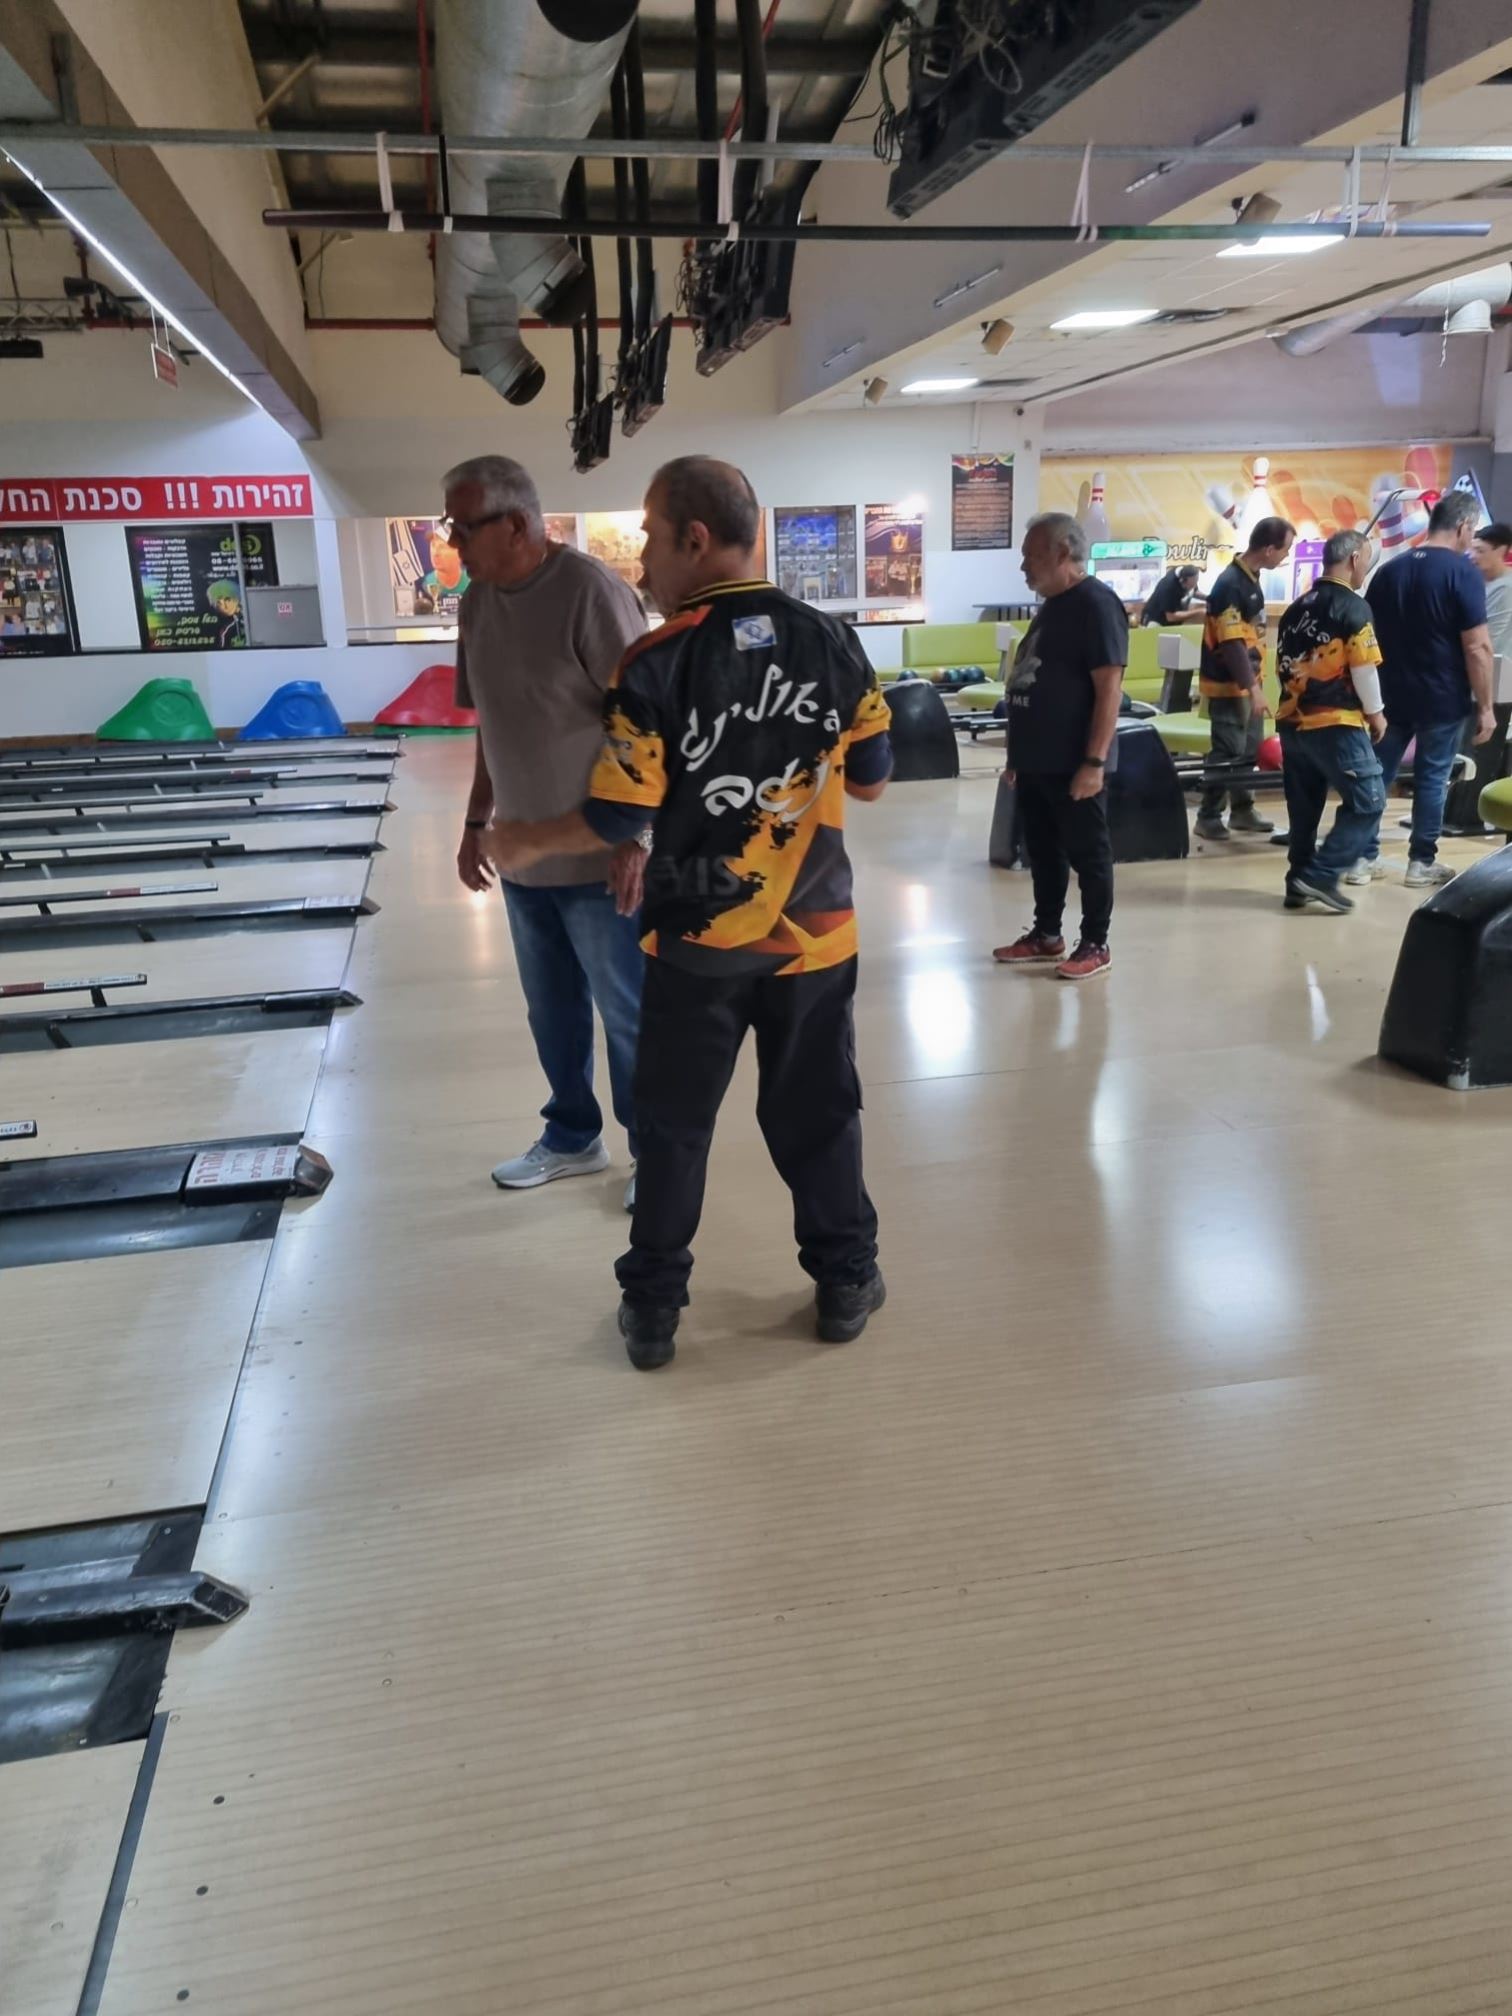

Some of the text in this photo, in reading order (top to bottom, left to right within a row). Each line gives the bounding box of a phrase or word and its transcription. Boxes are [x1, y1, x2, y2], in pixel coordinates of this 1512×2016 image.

[0, 481, 304, 513] זהירות !!! סכנת הח
[680, 663, 841, 772] באולינג
